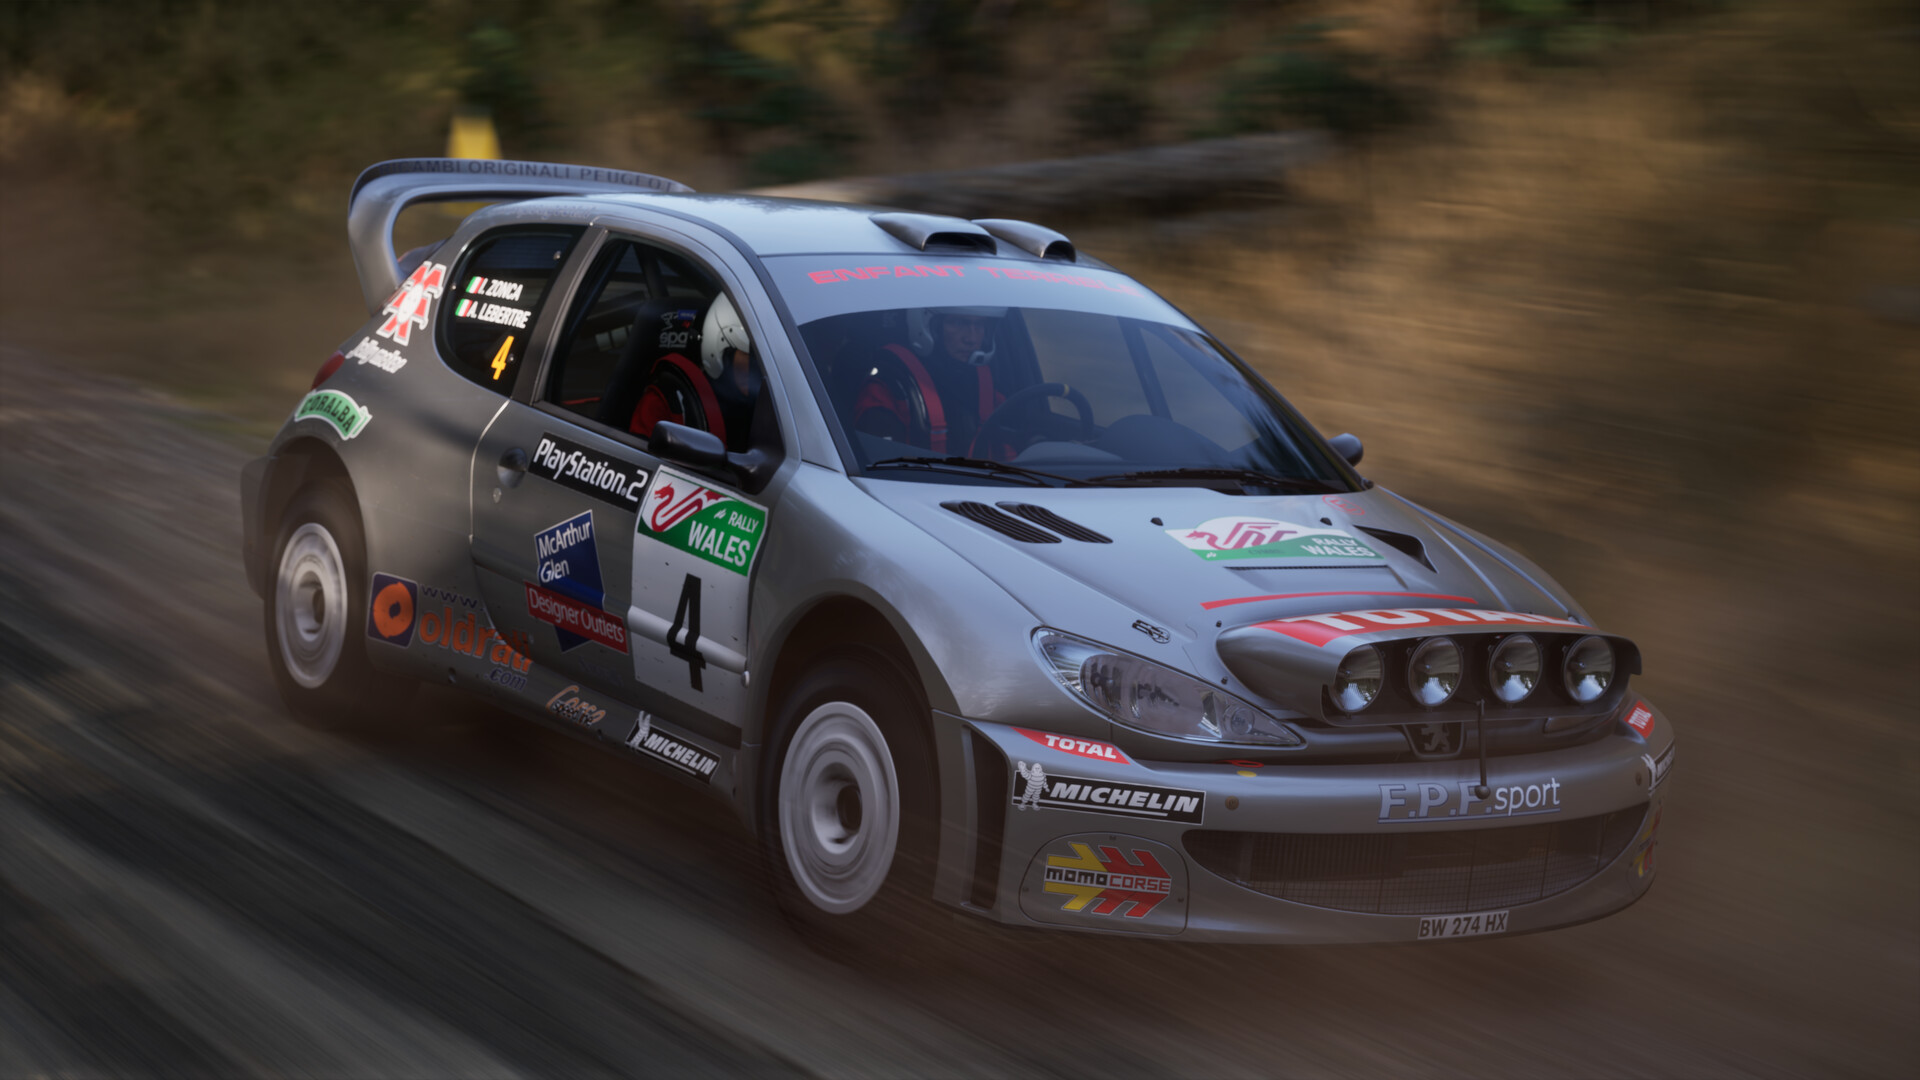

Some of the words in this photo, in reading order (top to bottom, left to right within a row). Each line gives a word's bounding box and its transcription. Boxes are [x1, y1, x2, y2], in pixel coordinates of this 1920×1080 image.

[467, 160, 571, 180] ORIGINALI
[485, 279, 524, 302] ZONCA
[807, 264, 965, 285] ENFANT
[978, 265, 1146, 299] TERRIBLE
[465, 303, 477, 319] A.
[477, 303, 532, 330] LEBERTRE
[490, 335, 515, 381] 4
[727, 510, 760, 534] RALLY
[538, 521, 591, 560] McArthur
[687, 519, 751, 568] WALES
[1300, 544, 1376, 557] WALES
[1311, 537, 1358, 547] RALLY
[540, 558, 570, 583] Glen
[421, 584, 485, 612] www.
[528, 587, 579, 626] Designer
[580, 608, 625, 644] Outlets
[666, 572, 706, 693] 4
[643, 732, 718, 776] MICHELIN
[1044, 734, 1117, 760] TOTAL
[1049, 782, 1200, 814] MICHELIN
[1418, 917, 1448, 938] BW
[1451, 915, 1481, 936] 274
[1484, 912, 1507, 933] HX
